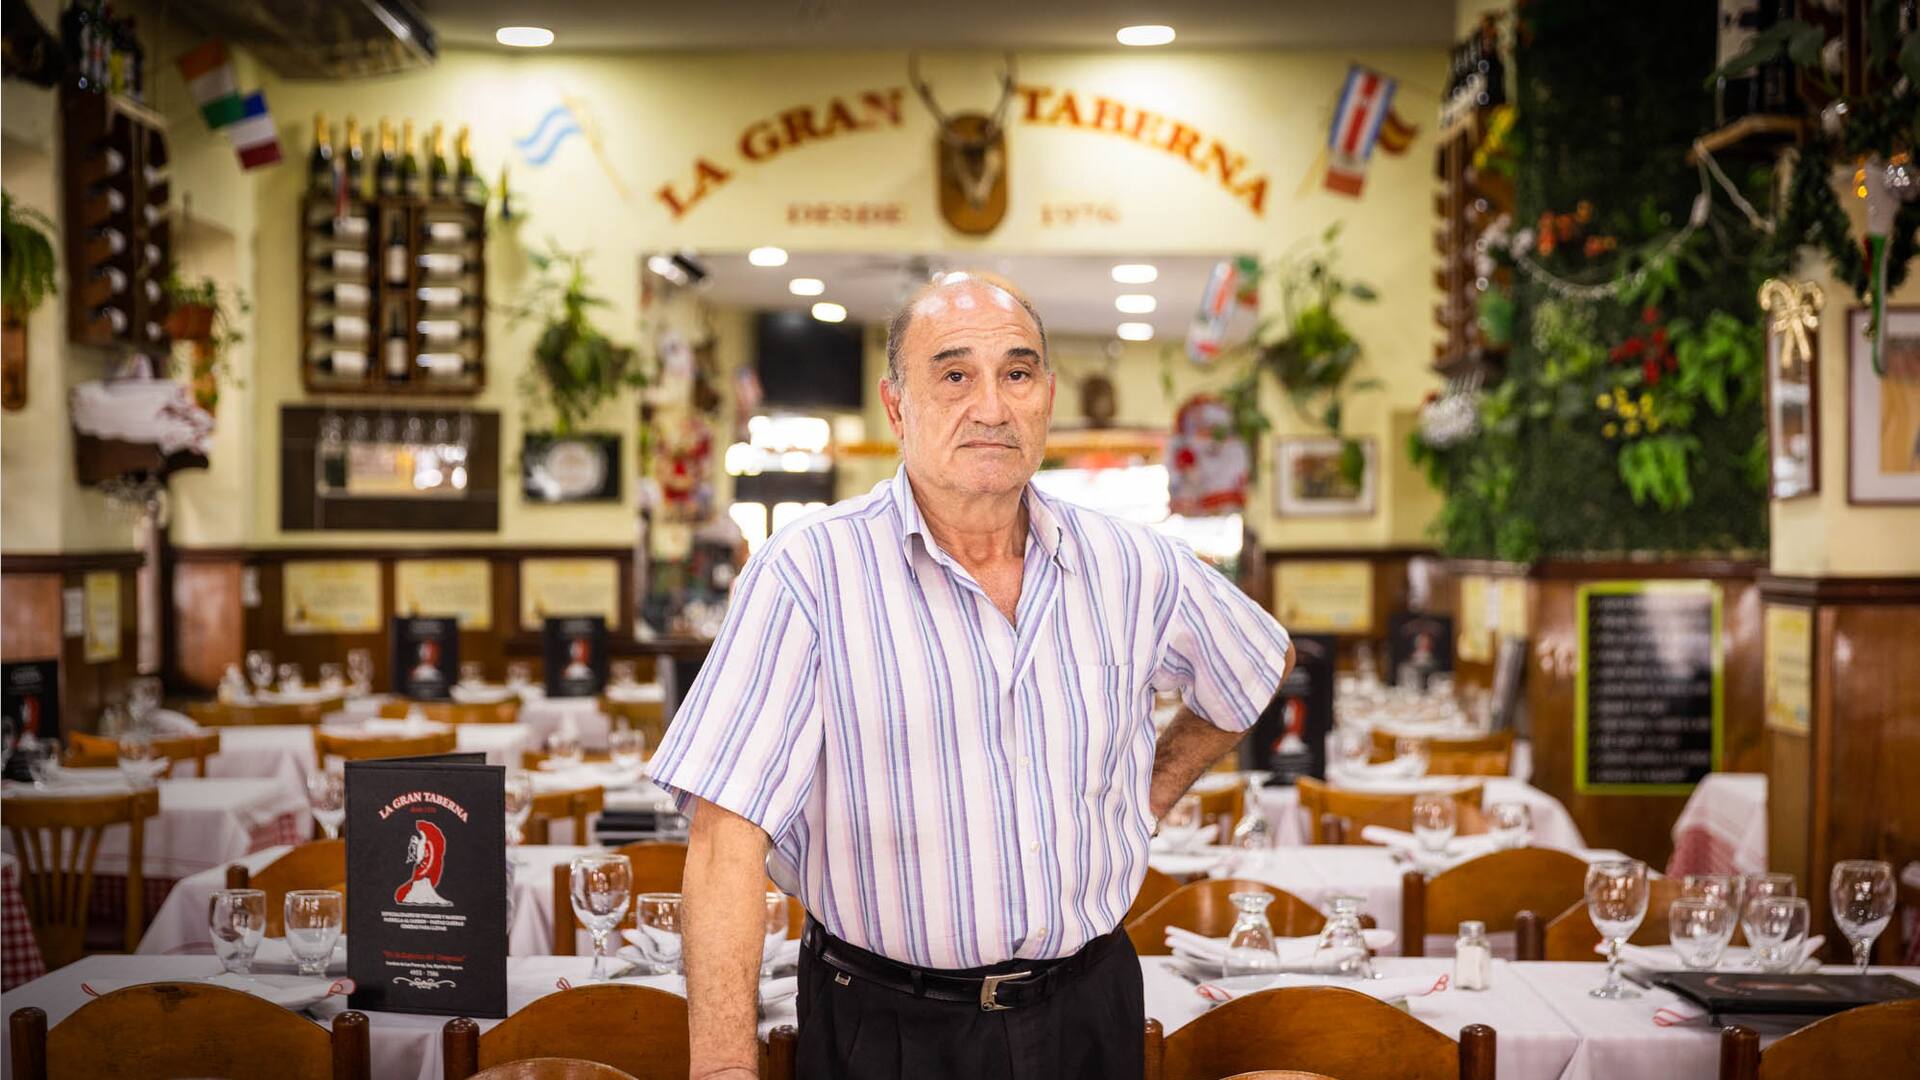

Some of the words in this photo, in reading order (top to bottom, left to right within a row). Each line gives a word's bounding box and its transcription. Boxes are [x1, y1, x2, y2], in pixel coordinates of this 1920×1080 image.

[656, 154, 732, 219] LA
[738, 88, 904, 163] GRAN
[1017, 85, 1270, 217] TABERNA
[379, 805, 394, 819] LA
[393, 792, 421, 809] GRAN
[423, 792, 468, 823] TABERNA
